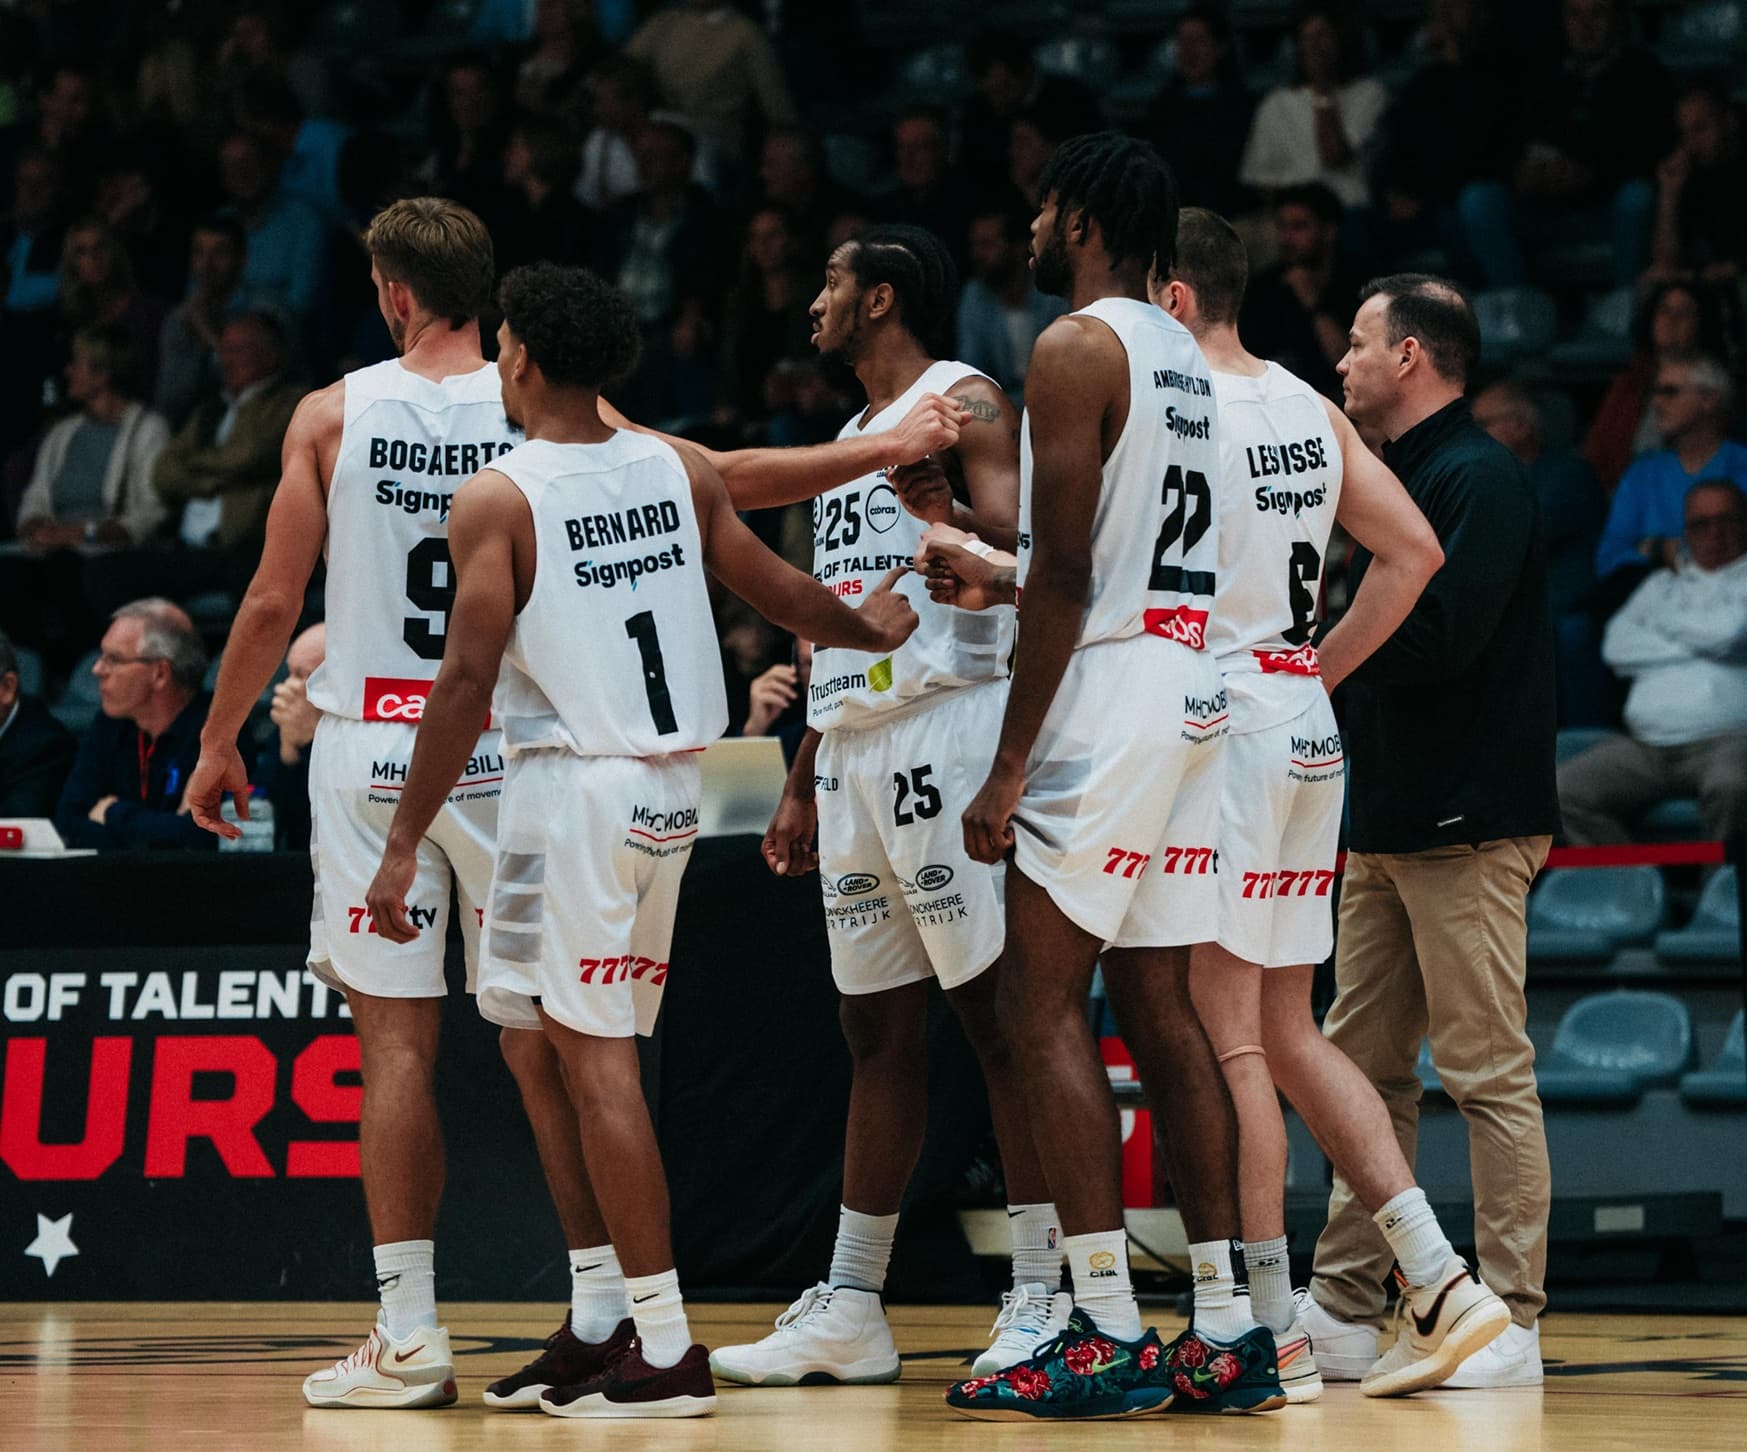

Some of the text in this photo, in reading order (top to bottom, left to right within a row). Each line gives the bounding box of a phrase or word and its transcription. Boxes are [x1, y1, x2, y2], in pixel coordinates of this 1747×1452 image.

[1246, 437, 1327, 478] LESISSE
[565, 499, 680, 551] BERNARD
[825, 491, 861, 552] 25
[1148, 464, 1216, 597] 22
[574, 543, 686, 592] Signpost
[824, 561, 840, 579] OF
[829, 579, 863, 598] URS
[403, 537, 455, 661] 9
[625, 610, 679, 737] 1
[810, 674, 866, 702] Trustteam
[893, 763, 943, 828] 25
[348, 904, 437, 934] 77tv
[4, 970, 353, 1021] OF TALENT
